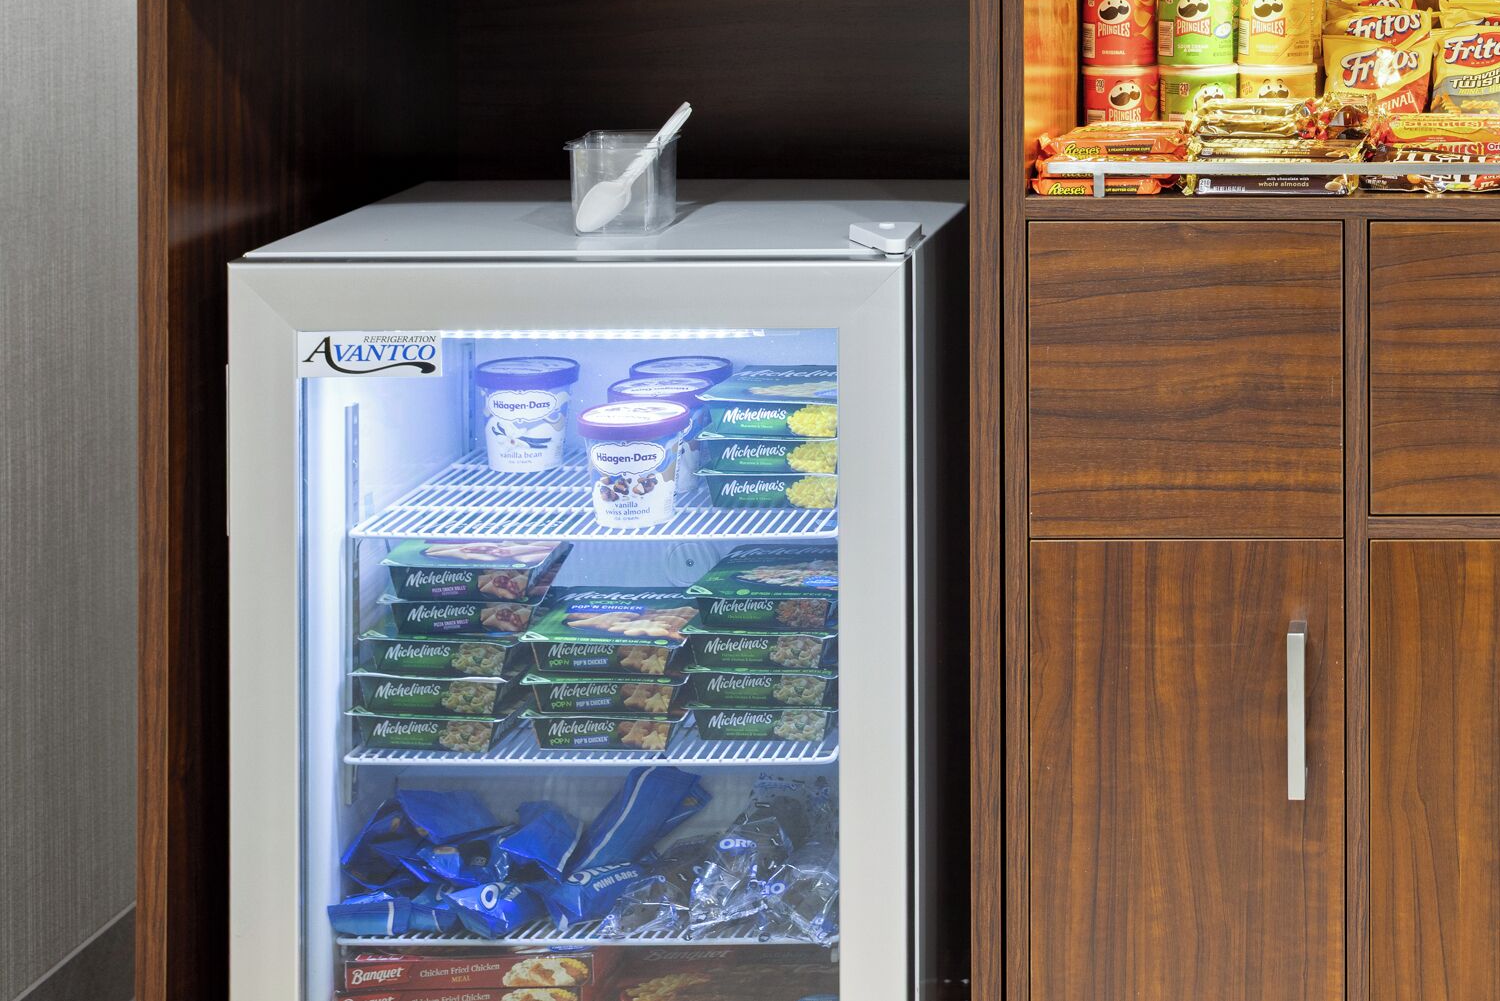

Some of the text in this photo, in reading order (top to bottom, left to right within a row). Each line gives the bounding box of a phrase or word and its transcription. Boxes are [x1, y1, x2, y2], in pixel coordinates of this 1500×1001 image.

[1098, 23, 1130, 38] PRINGLES
[1176, 18, 1210, 35] PRINGLES
[1252, 19, 1283, 35] PRINGLES
[1347, 11, 1421, 40] Fritos
[1109, 108, 1141, 121] PRINGLES
[364, 335, 436, 343] REFRIGERATION
[302, 336, 436, 368] AVANTCO
[493, 400, 550, 411] Häagen-Dazs
[723, 407, 787, 424] Michelina's
[524, 451, 542, 459] bean
[596, 452, 657, 465] Häagen-Dazs
[722, 444, 786, 460] Michelina's
[721, 480, 785, 496] Michelina's
[406, 570, 472, 587] Michelina's
[408, 605, 475, 621] Michelina's
[710, 599, 774, 615] Michelina's
[385, 644, 450, 660] Michelina's
[548, 643, 614, 658] Michelina's
[704, 637, 768, 654] Michelina's
[375, 681, 440, 699] Michelina's
[707, 675, 772, 691] Michelina's
[551, 684, 618, 699] Michelina's
[549, 720, 615, 736] Michelina's
[709, 712, 772, 728] Michelina's
[373, 720, 438, 737] Michelina's
[352, 967, 404, 985] Banquet
[420, 963, 500, 978] Chicken Fried Chicken
